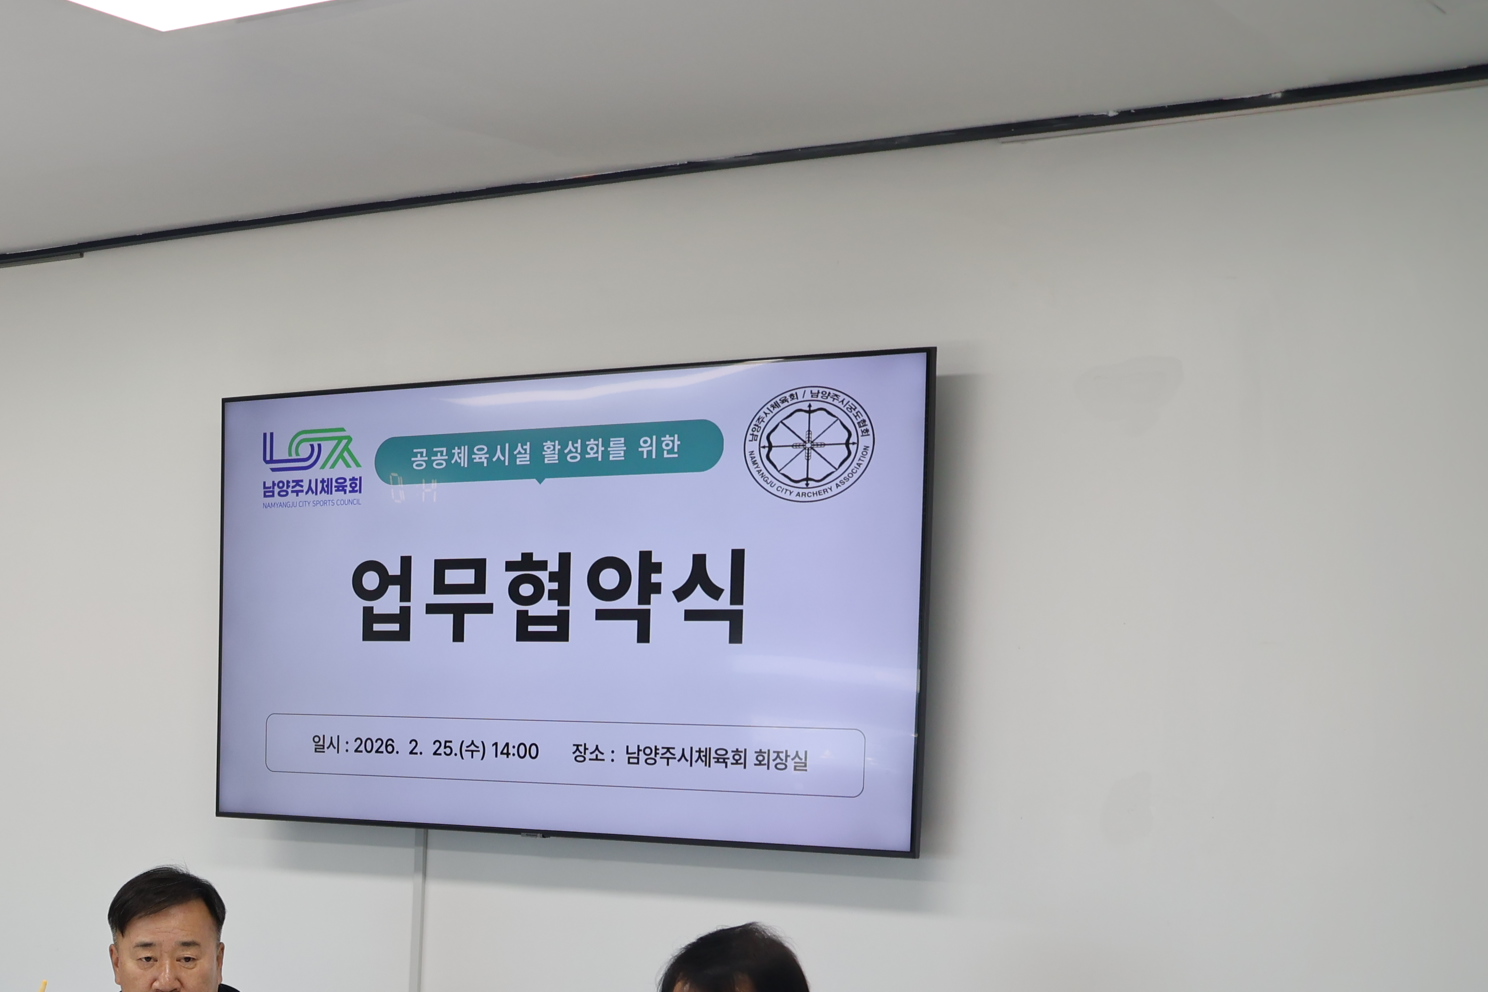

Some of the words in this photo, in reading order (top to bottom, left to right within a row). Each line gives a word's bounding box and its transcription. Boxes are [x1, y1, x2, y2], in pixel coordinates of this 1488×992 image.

[748, 391, 799, 442] 남양주시체육회
[810, 389, 871, 437] 남양주시궁도협회
[411, 442, 532, 471] 공공체육시설
[542, 436, 628, 464] 활성화를
[638, 434, 681, 459] 위한
[263, 476, 362, 498] 남양주시체육회
[748, 450, 777, 489] NAMYANGJU
[776, 485, 794, 497] CITY
[795, 486, 833, 498] ARCHERY
[835, 445, 870, 489] ASSOCIATION
[263, 501, 298, 509] NAMYANGJU
[312, 499, 335, 507] SPORTS
[336, 498, 361, 506] COUNCIL
[351, 548, 746, 644] 업무협약식
[312, 734, 340, 754] 일시
[354, 737, 400, 755] 2026.
[408, 739, 423, 756] 2.
[432, 739, 486, 761] 25.(수)
[492, 741, 540, 760] 14:00
[572, 743, 606, 763] 장소
[625, 744, 748, 769] 남양주시체육회
[753, 748, 809, 772] 회장실
